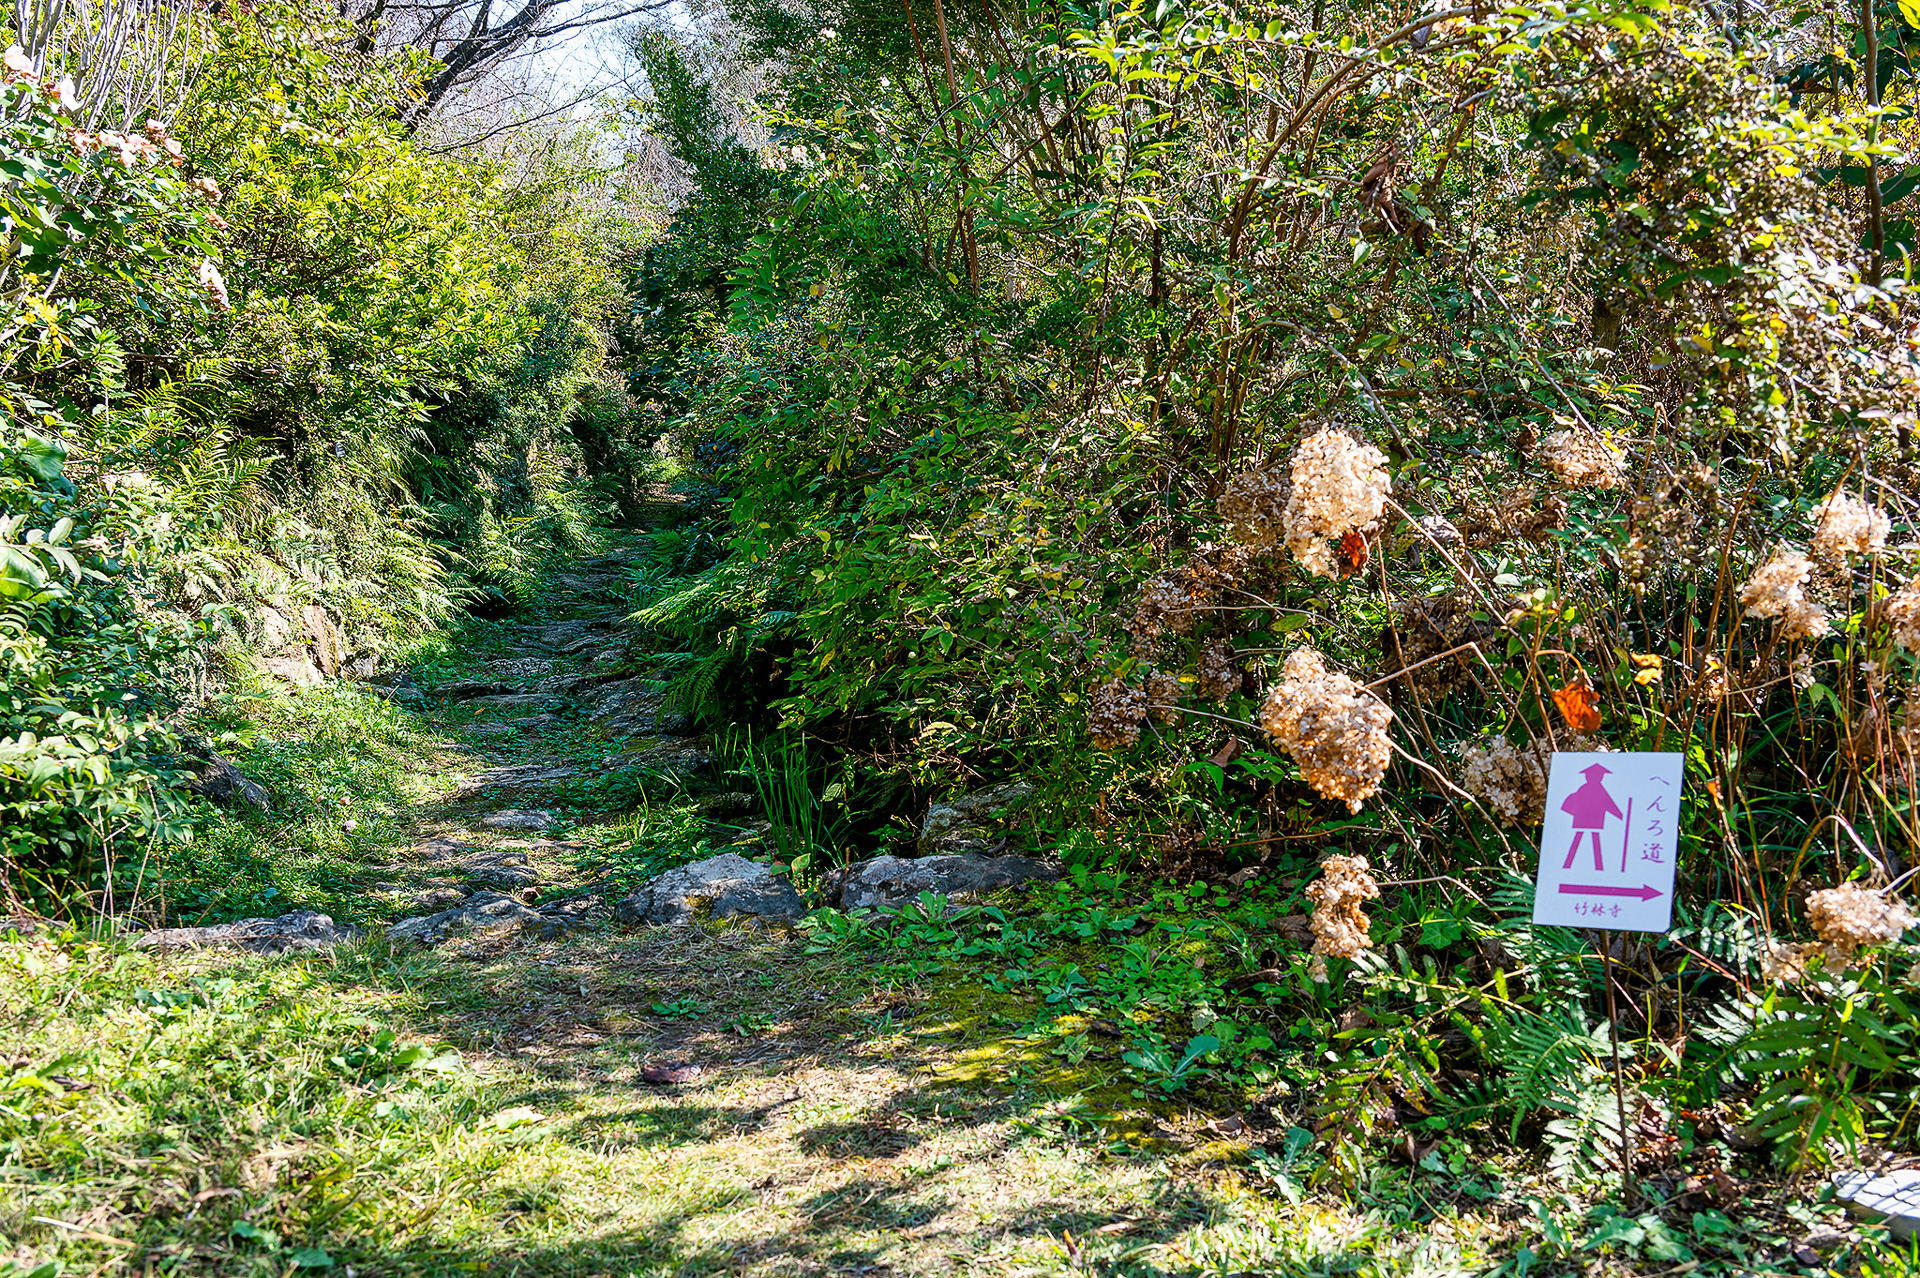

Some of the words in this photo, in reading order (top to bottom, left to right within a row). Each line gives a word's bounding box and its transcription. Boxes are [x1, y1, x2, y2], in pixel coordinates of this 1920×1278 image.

[1641, 776, 1670, 863] へんろ道
[1574, 901, 1623, 918] 竹林寺
